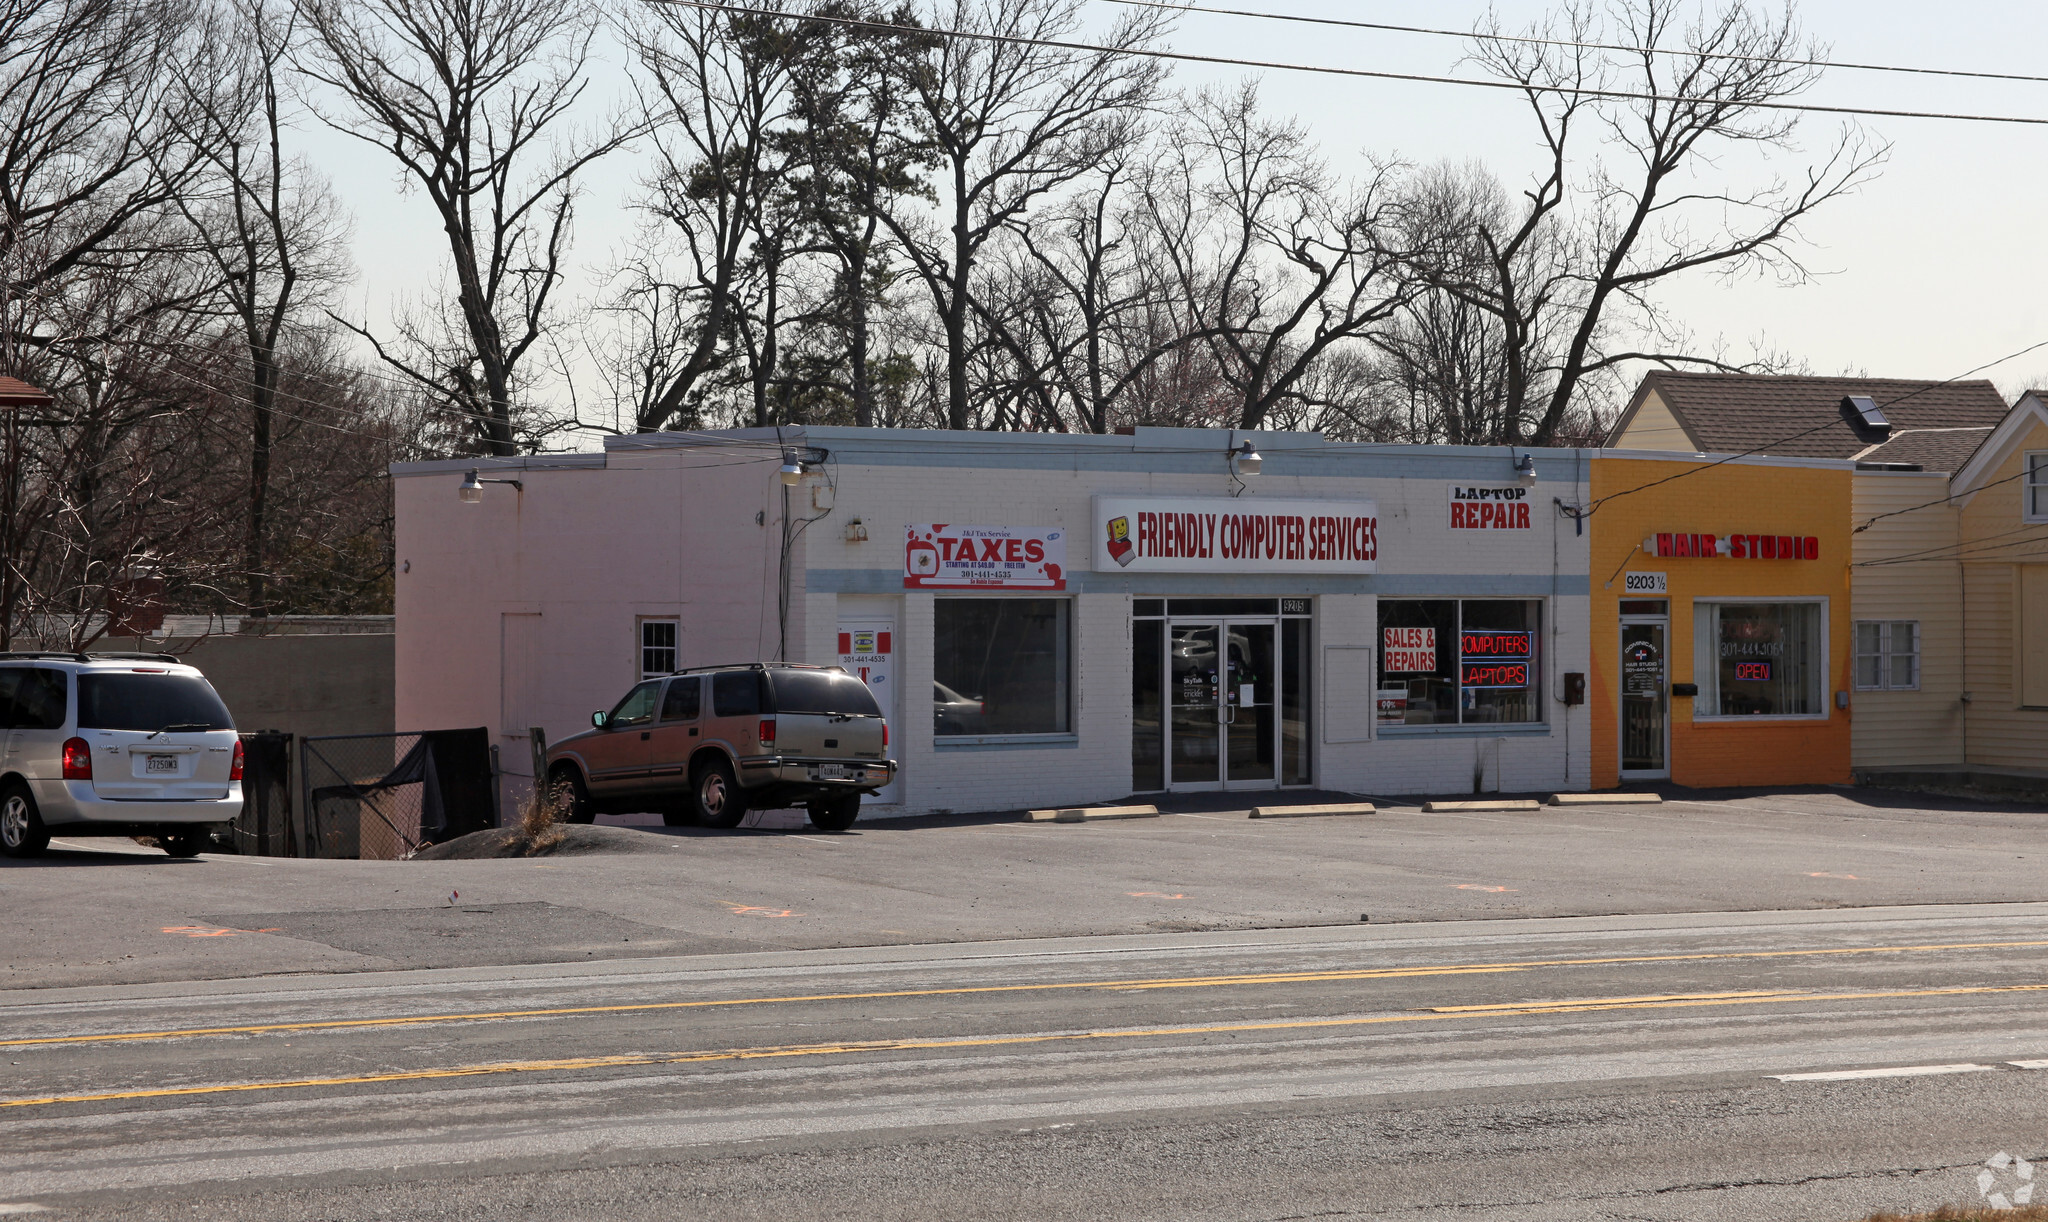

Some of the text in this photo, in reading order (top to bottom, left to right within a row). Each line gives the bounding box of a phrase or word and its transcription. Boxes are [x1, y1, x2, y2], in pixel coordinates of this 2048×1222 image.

[1454, 487, 1527, 500] LAPTOP
[1450, 502, 1531, 529] REPAIR
[1137, 511, 1377, 562] FRIENDLY COMPUTER SERVICES
[937, 537, 1045, 563] TAXES
[1654, 532, 1819, 561] HAIR STUDIO
[945, 561, 970, 569] STARTING
[970, 561, 977, 569] AT
[961, 570, 1012, 578] 301-441-4535
[1626, 575, 1655, 590] 9203
[1283, 600, 1304, 612] 9205
[1385, 628, 1435, 649] SALES &
[1461, 635, 1529, 654] COMPUTERS
[1624, 640, 1658, 654] DOMINICAN
[1720, 642, 1784, 657] 301-441-1061
[843, 655, 886, 663] 301-441-4535
[1385, 651, 1435, 671] REPAIRS
[1461, 665, 1525, 685] LAPTOPS
[1737, 664, 1769, 679] OPEN
[1183, 677, 1203, 685] SkyTalk
[1183, 688, 1204, 698] cricket
[148, 760, 178, 770] 27250M3
